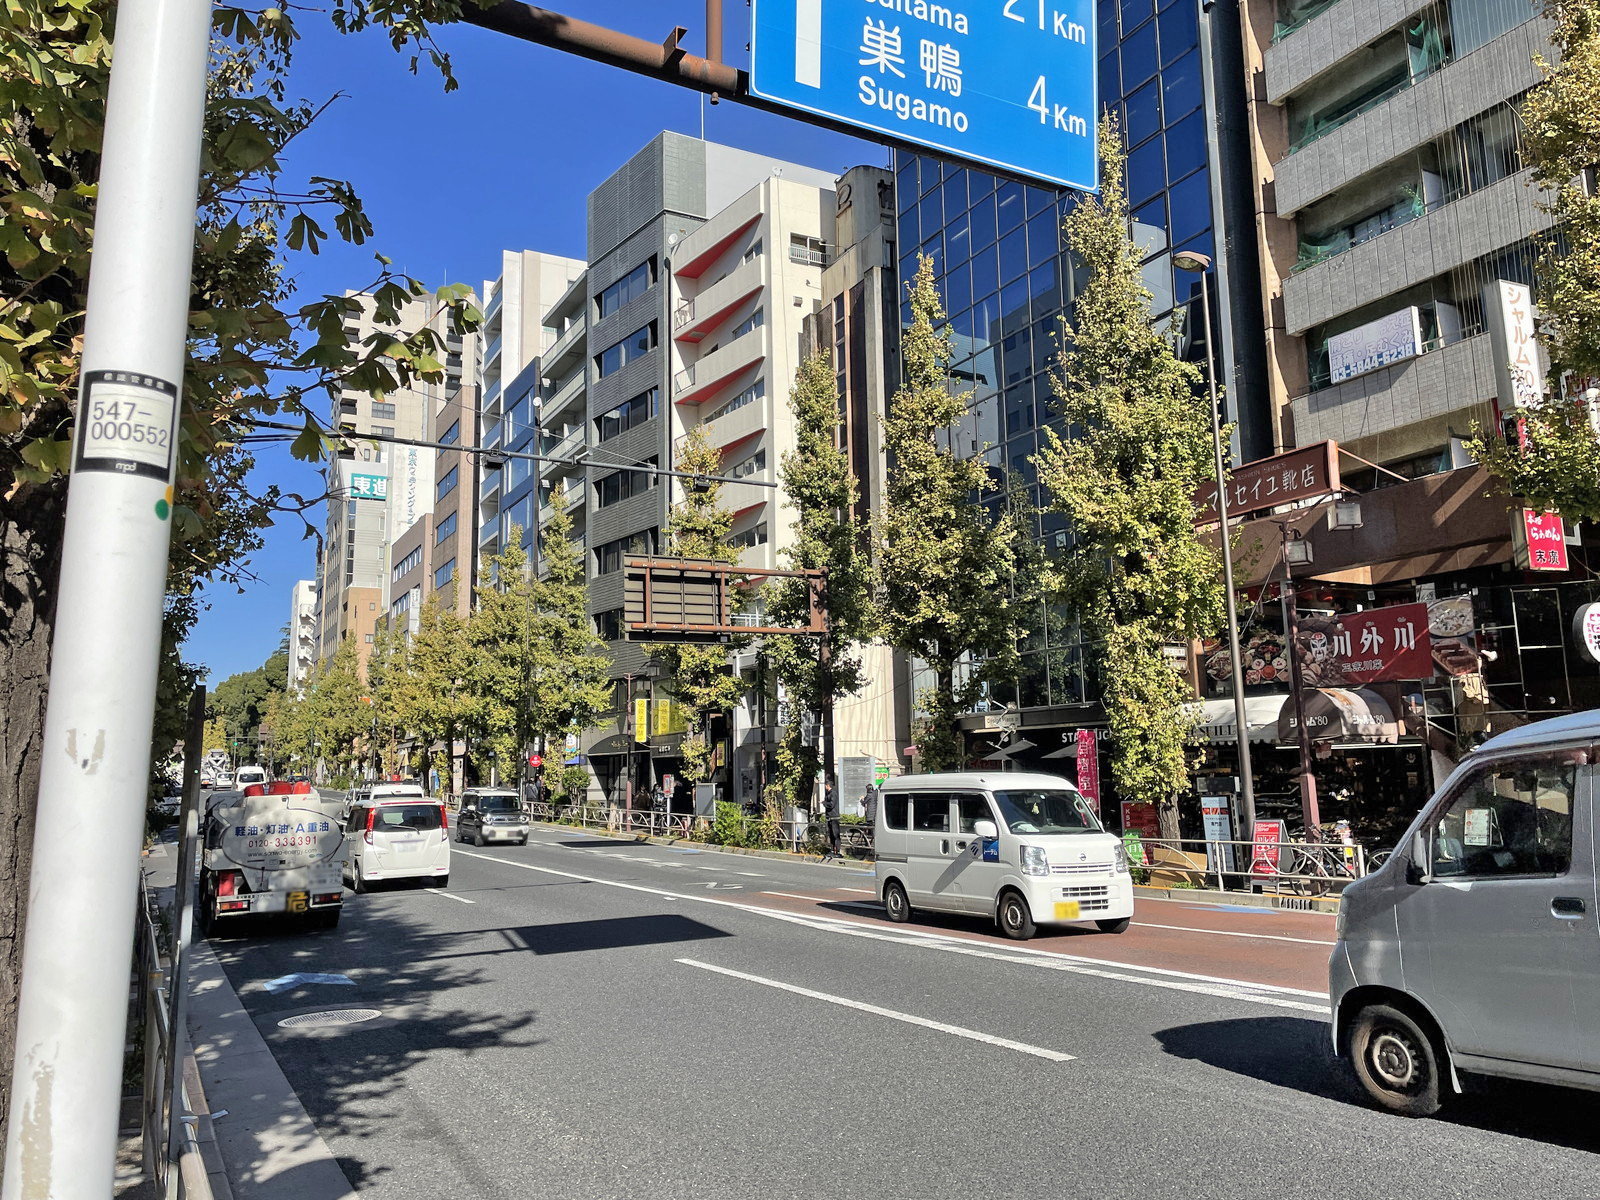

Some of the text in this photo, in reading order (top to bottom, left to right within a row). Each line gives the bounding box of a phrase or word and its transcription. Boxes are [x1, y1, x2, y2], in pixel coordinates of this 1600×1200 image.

[864, 0, 969, 36] tama
[1053, 10, 1086, 45] Km
[858, 16, 963, 97] 巣鴨
[858, 75, 1087, 138] Sugamo 4 Km
[1508, 287, 1535, 387] シャルム0
[1332, 345, 1414, 383] 03-5844-6238
[93, 401, 152, 422] 547-
[91, 421, 168, 448] 000552
[115, 462, 137, 473] mpd
[353, 476, 387, 496] 東進
[1332, 622, 1416, 658] 川外川
[248, 834, 318, 848] 0120-333391
[286, 891, 309, 913] 危
